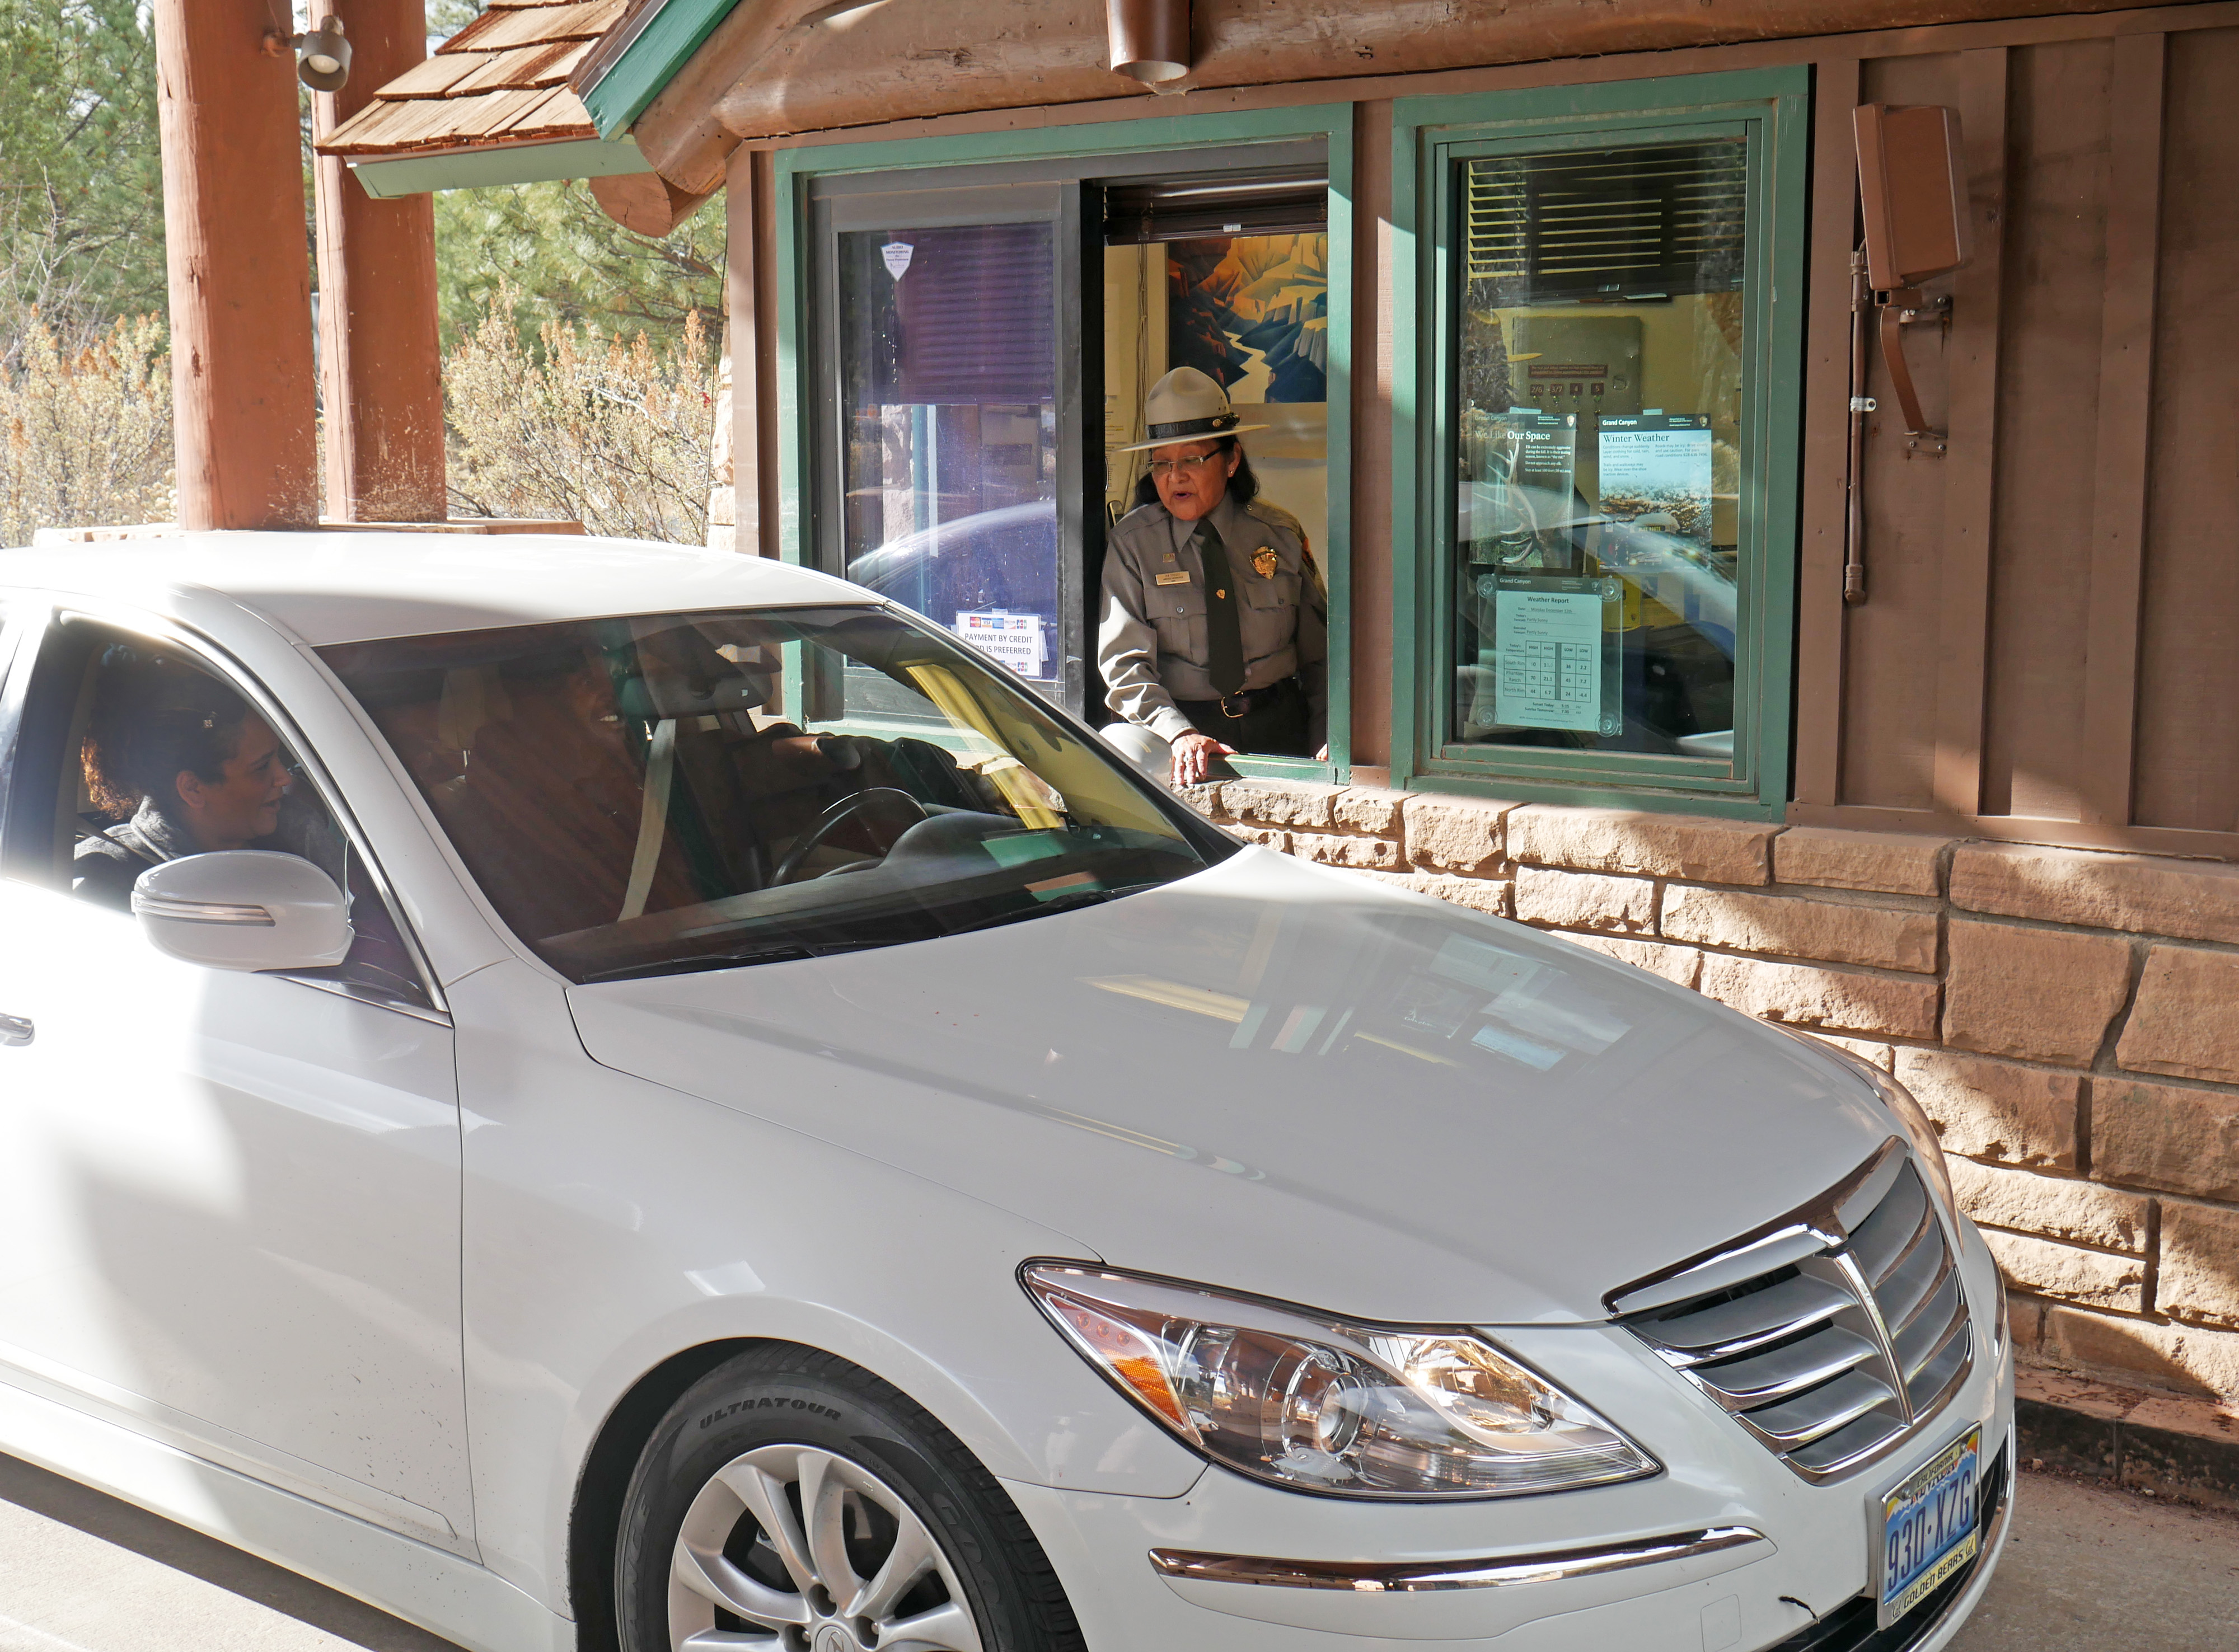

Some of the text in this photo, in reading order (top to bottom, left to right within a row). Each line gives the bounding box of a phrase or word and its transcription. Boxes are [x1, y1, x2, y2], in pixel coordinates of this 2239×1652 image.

[1475, 430, 1551, 442] We Like Our Space
[1603, 433, 1670, 443] Winter Weather
[964, 633, 997, 642] PAYMENT
[994, 646, 1031, 655] PREFERRED
[700, 1397, 842, 1430] ULTRATOUR
[1917, 1452, 1954, 1488] CALIFORNIA
[1904, 1573, 1936, 1609] GOLDEN
[1937, 1548, 1964, 1580] BEARS
